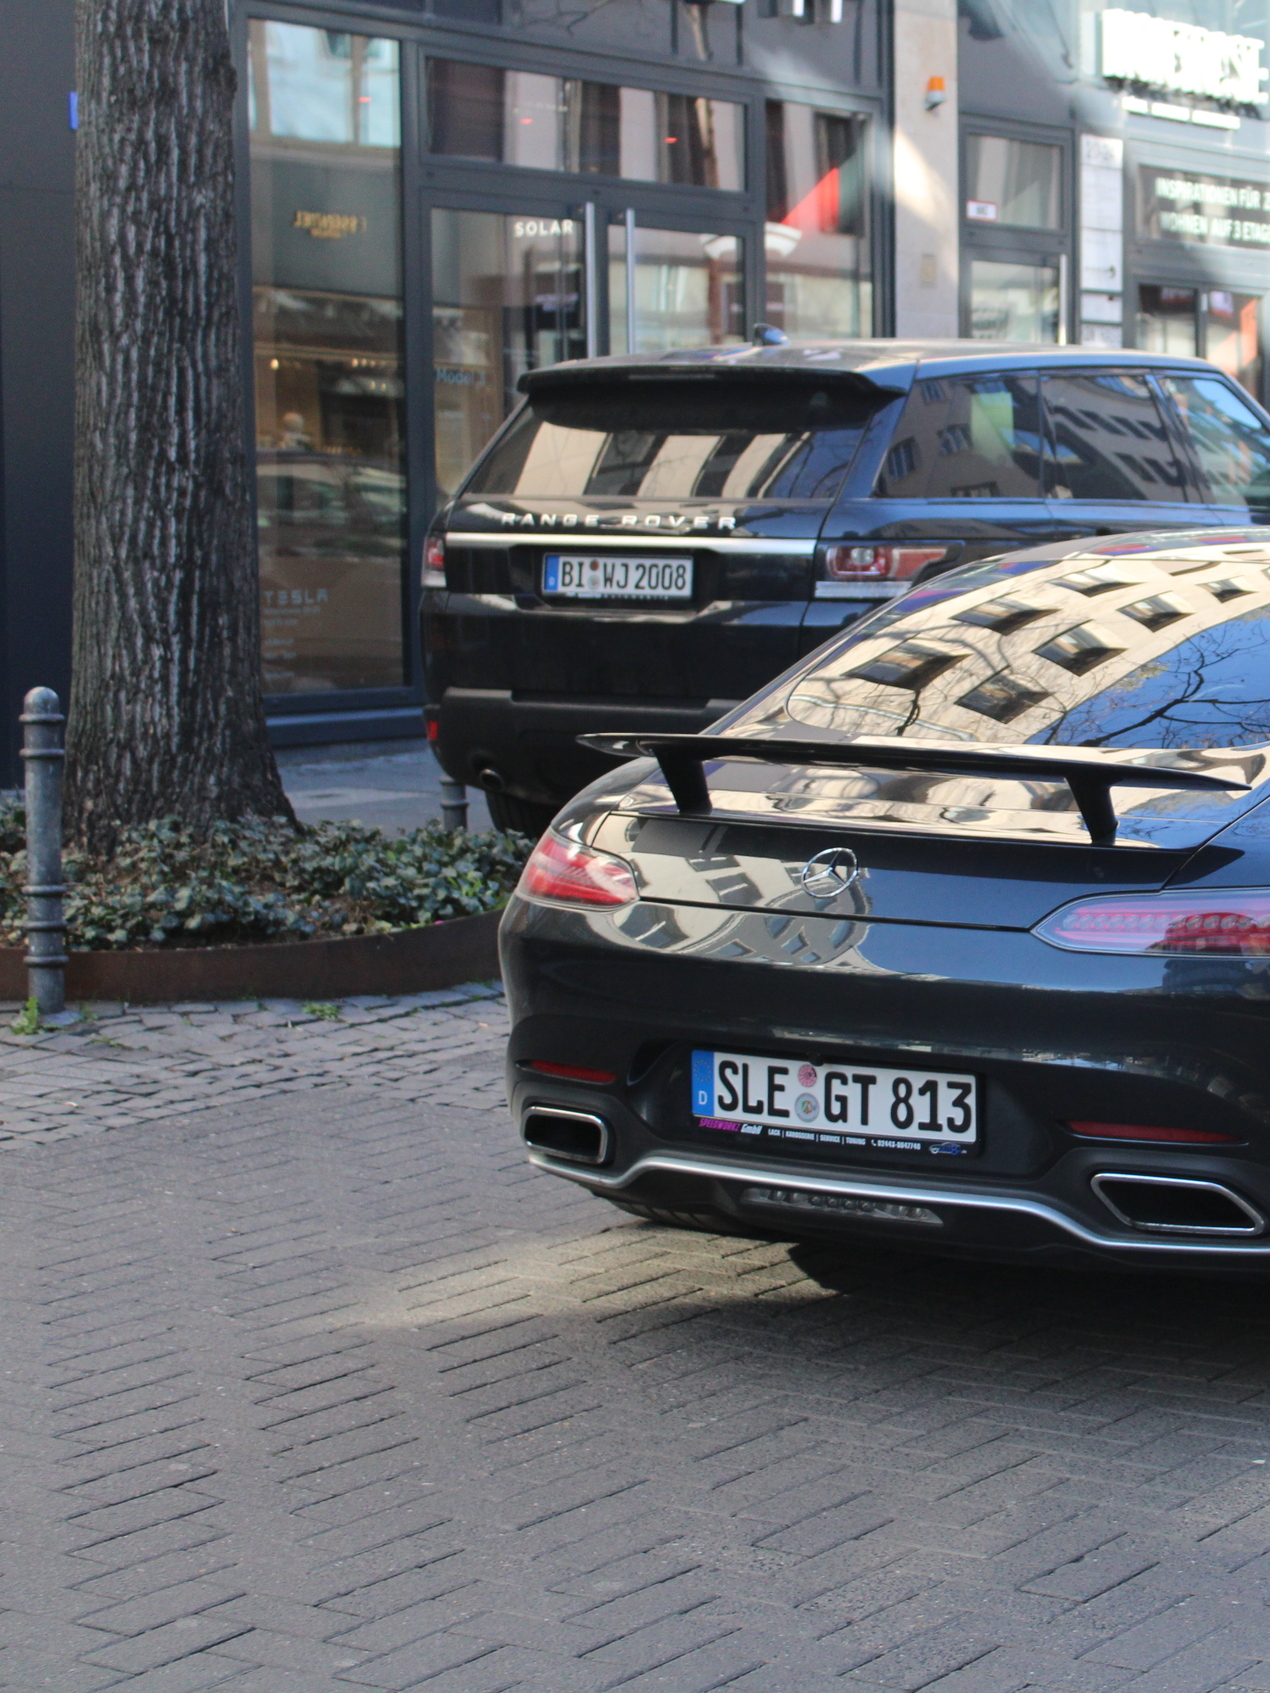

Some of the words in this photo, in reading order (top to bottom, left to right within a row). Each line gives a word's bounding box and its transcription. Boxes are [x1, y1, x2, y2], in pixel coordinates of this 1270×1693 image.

[1155, 177, 1238, 207] INSPIRATIONEN
[1238, 186, 1261, 209] FÜR
[514, 219, 573, 238] SOLAR
[1160, 211, 1208, 234] WOHNEN
[1210, 218, 1232, 239] AUF
[1233, 220, 1241, 240] 3
[436, 368, 475, 385] Model
[501, 513, 599, 527] RANGE
[621, 515, 736, 530] ROVER
[561, 561, 585, 587] BI
[603, 563, 629, 590] WJ
[635, 563, 686, 590] 2008
[264, 588, 328, 606] TESLA
[699, 1091, 707, 1105] D
[717, 1060, 790, 1118] SLE
[824, 1071, 877, 1126] GT
[890, 1077, 972, 1134] 813
[740, 1123, 763, 1135] GmbH
